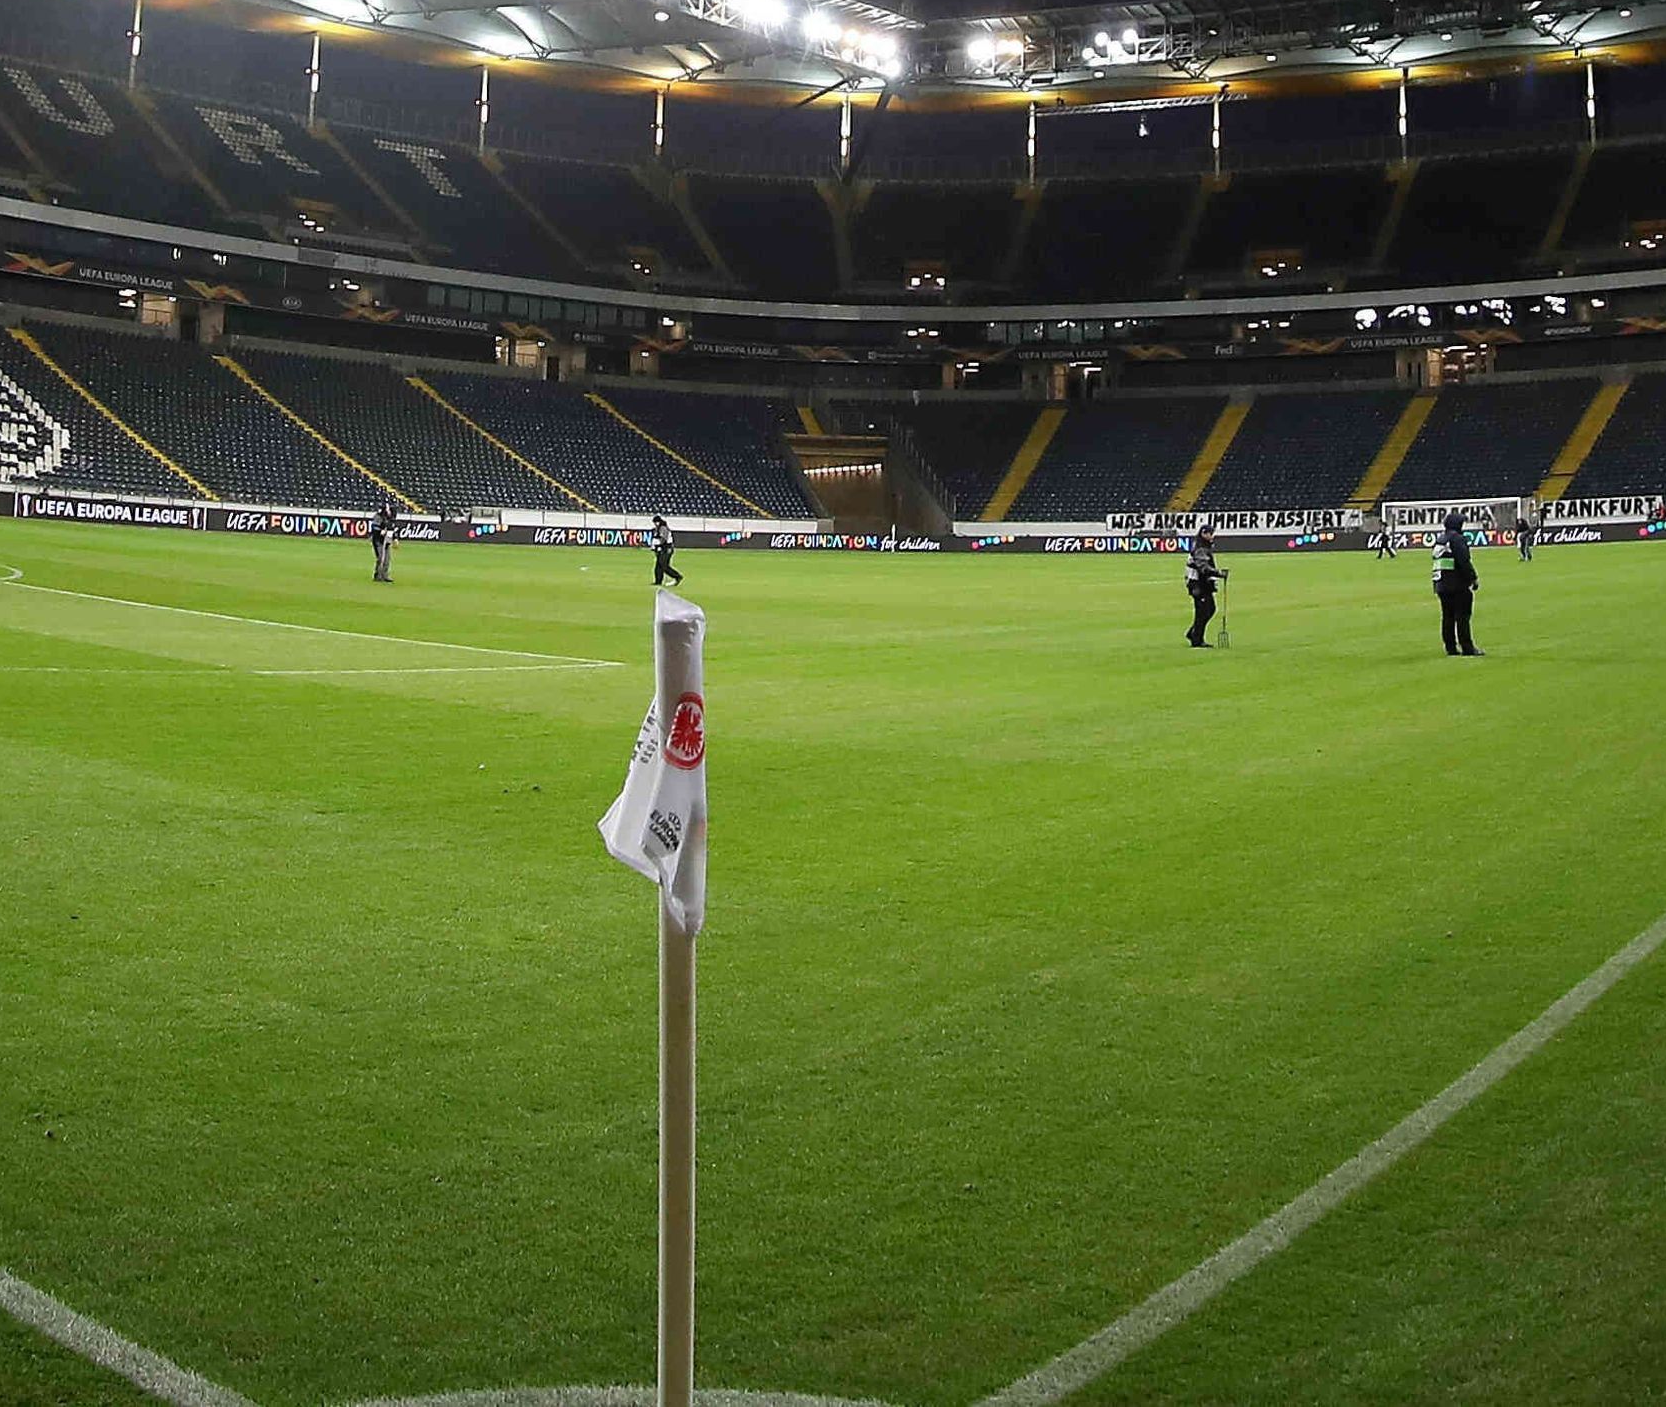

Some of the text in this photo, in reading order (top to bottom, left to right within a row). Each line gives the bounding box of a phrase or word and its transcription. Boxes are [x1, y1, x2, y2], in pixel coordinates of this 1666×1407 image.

[79, 268, 173, 290] UEFA EUROPA LEAGUE
[405, 313, 489, 332] UEFA EUROPA LEAGUE
[693, 343, 779, 356] UEFA EUROPA LEAGUE
[35, 500, 188, 525] UEFA EUROPA LEAGUE
[1543, 497, 1655, 518] FRANKFURT
[227, 513, 268, 531] UEFA
[400, 523, 440, 540] children
[1112, 510, 1346, 530] WAS AUCH IMMER PASSIERT
[534, 528, 653, 545] UEFA FOUNDATION
[770, 534, 796, 548] UEFA
[797, 534, 878, 549] FOUNDATION
[899, 537, 941, 550] children
[1554, 527, 1602, 542] children
[1045, 537, 1190, 552] UEFA FOUNDATION
[649, 809, 680, 852] EUROPA
